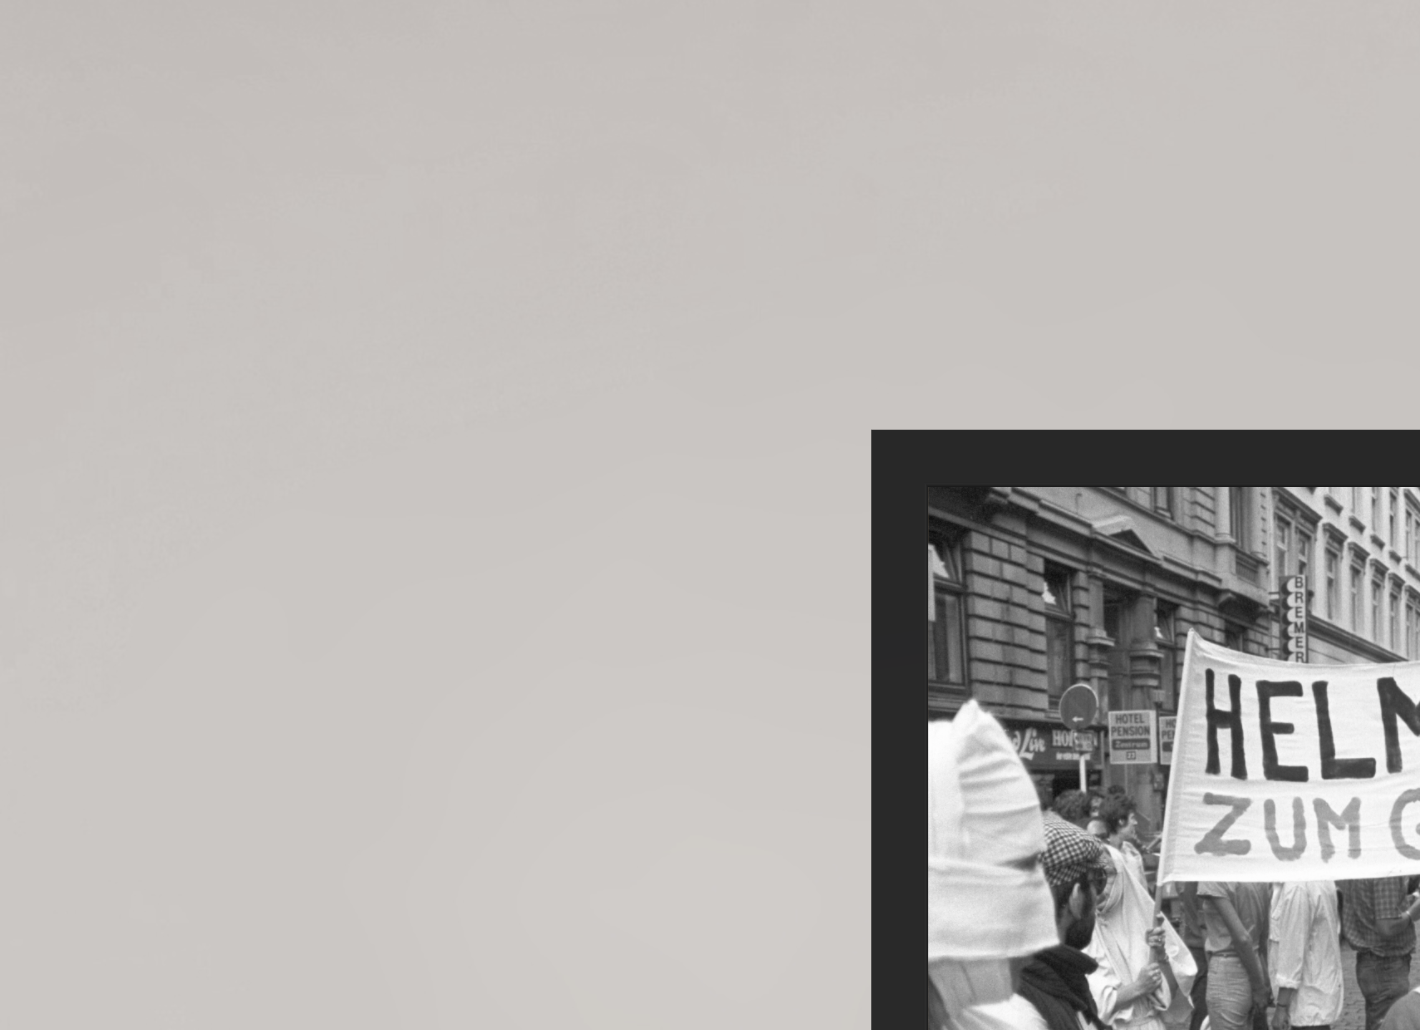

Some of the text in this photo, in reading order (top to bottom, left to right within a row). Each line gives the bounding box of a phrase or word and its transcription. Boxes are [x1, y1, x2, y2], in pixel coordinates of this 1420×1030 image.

[1294, 576, 1305, 663] BREMER
[1111, 725, 1151, 736] PENSION
[1115, 713, 1145, 724] HOTEL
[1194, 792, 1362, 863] ZUM
